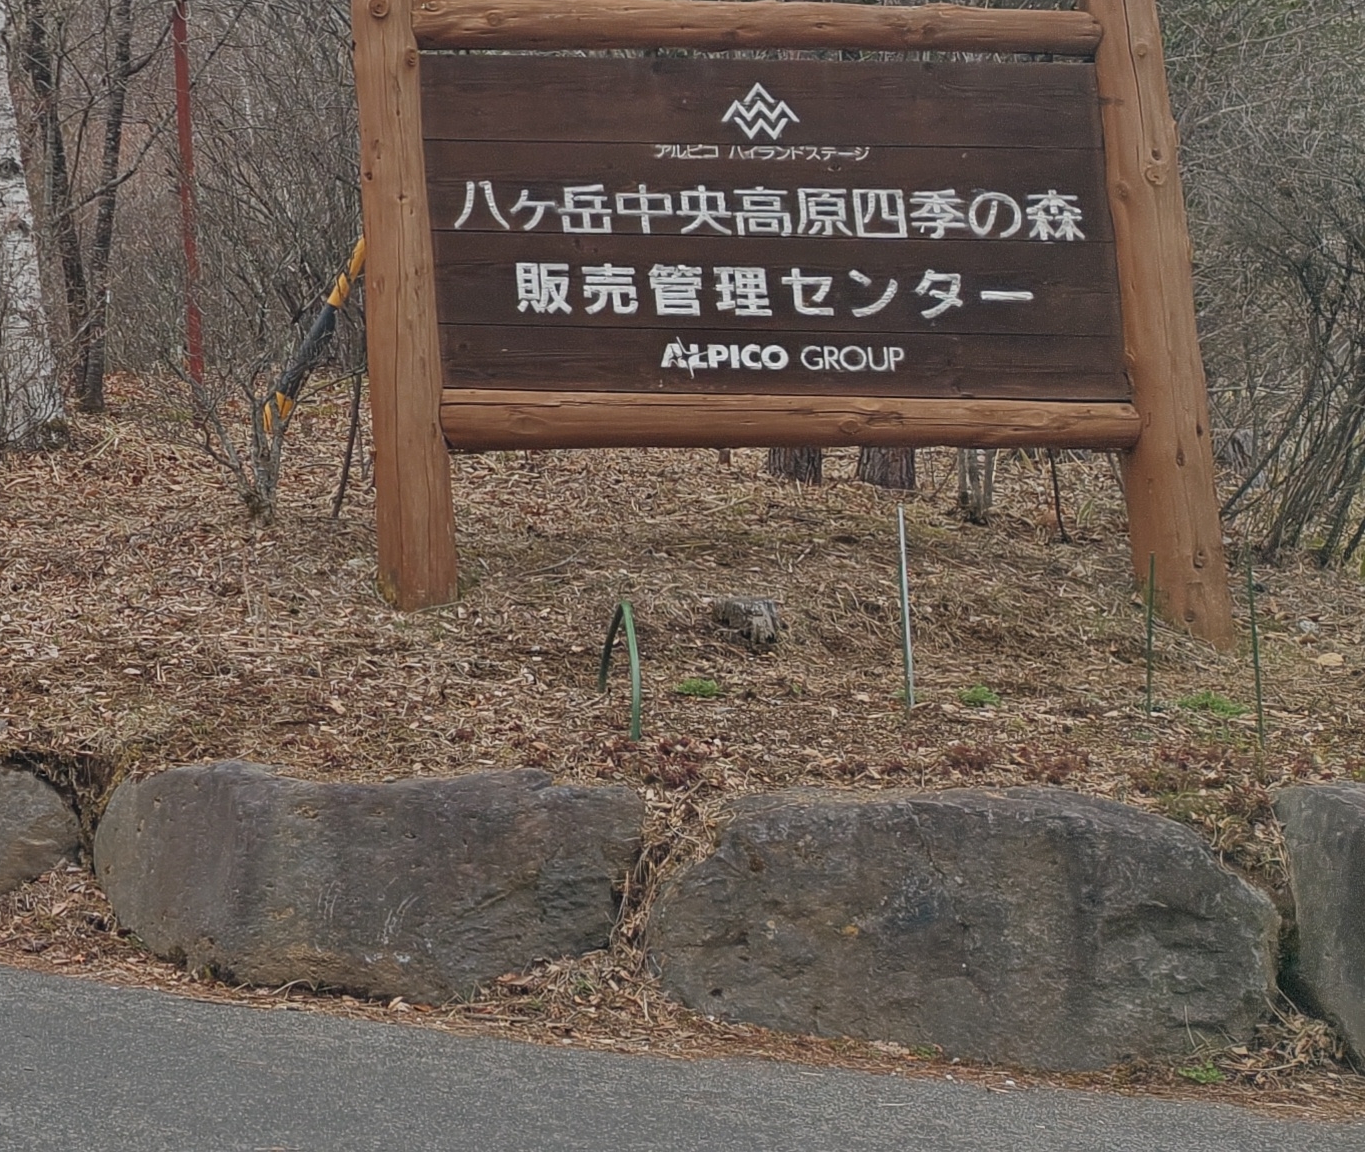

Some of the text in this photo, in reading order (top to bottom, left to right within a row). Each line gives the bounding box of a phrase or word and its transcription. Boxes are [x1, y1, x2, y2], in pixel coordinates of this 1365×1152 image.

[728, 145, 870, 161] ハイランドステージ
[515, 261, 1035, 319] 販売管理センター
[660, 338, 905, 377] ALPICO GROUP
